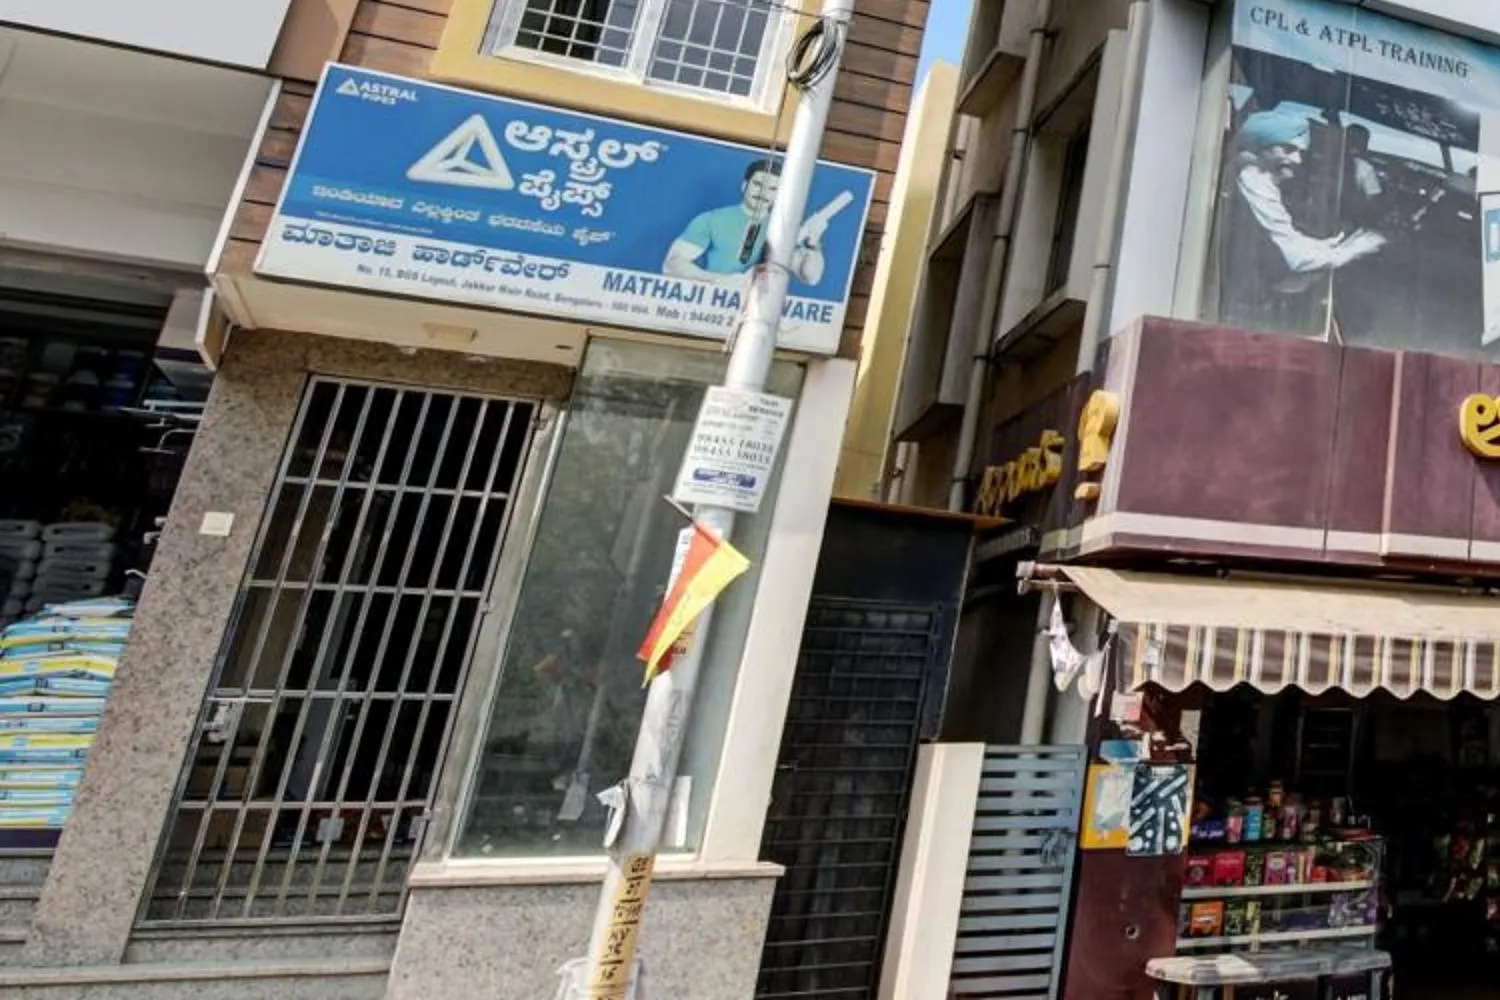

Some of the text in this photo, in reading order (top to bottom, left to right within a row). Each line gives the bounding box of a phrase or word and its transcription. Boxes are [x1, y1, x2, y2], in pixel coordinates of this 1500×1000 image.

[1250, 6, 1469, 79] CPL & ATPL TRAINING
[359, 81, 417, 102] ASTRAL
[602, 270, 834, 324] MATHAJI HAWARE
[656, 305, 680, 320] Mob
